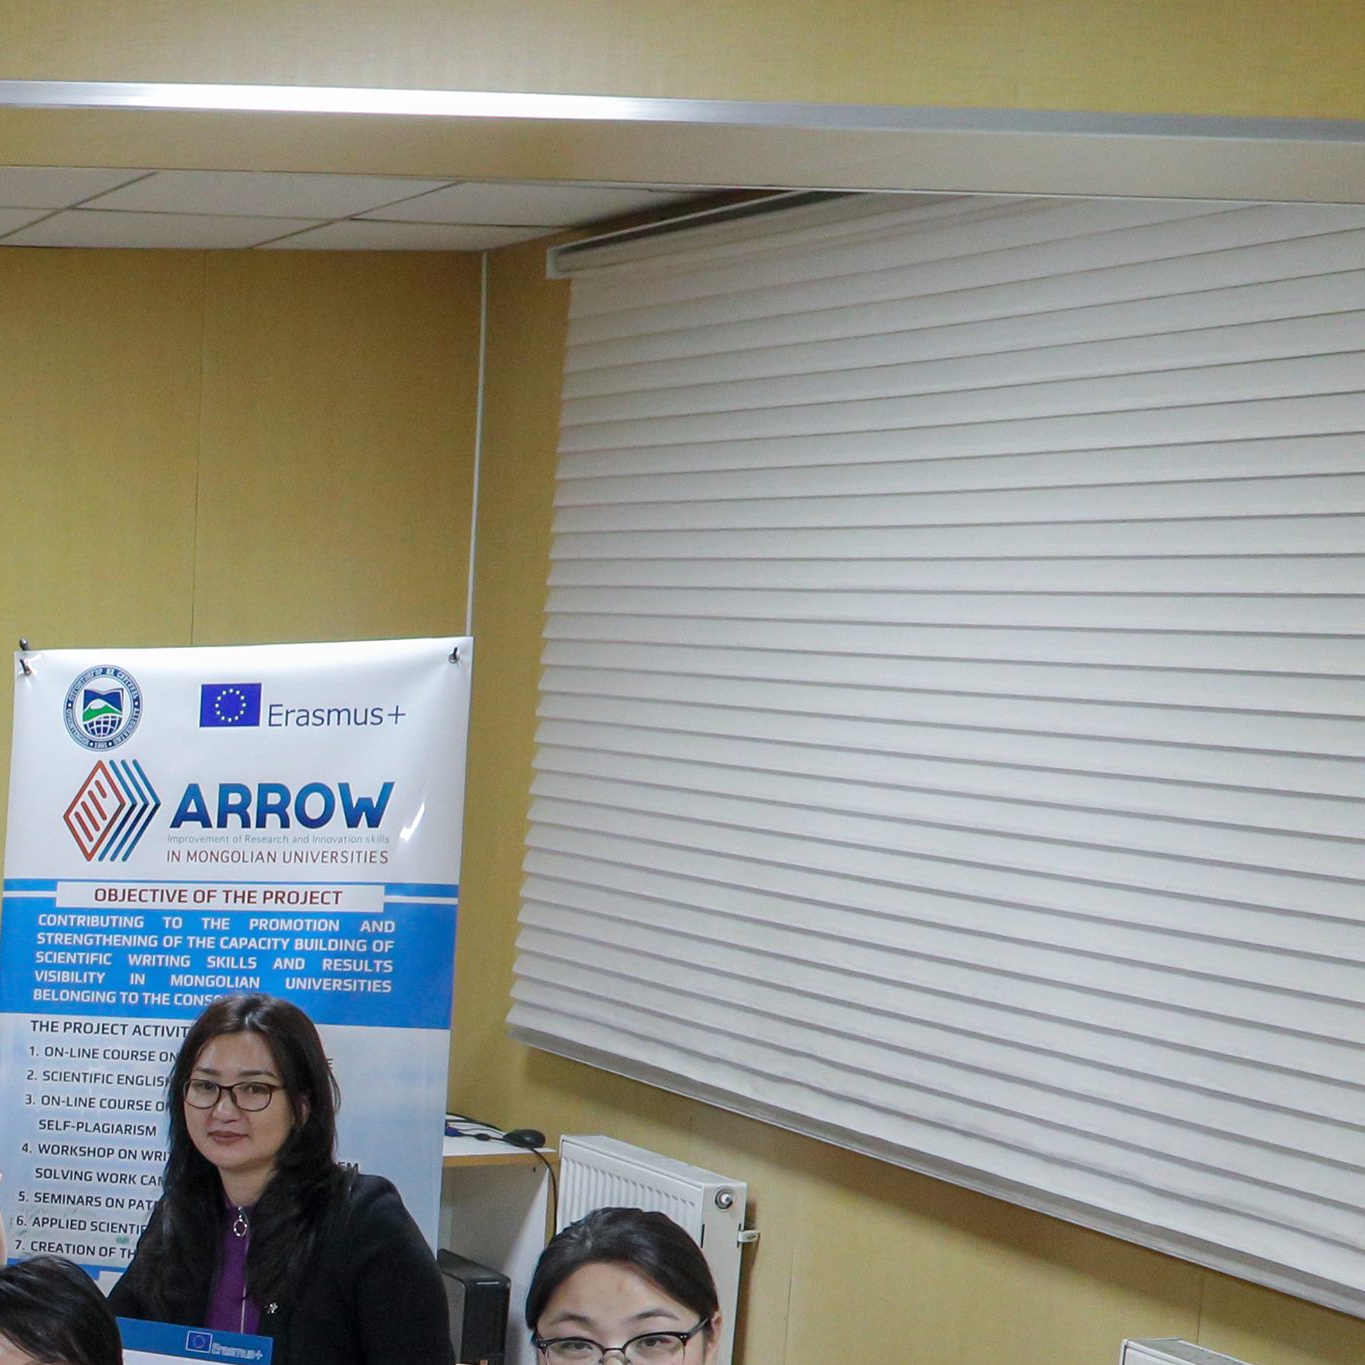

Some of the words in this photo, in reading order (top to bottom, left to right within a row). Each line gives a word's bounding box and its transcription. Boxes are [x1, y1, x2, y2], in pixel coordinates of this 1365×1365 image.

[268, 704, 406, 727] Erasmus+
[170, 782, 395, 829] ARROW
[168, 835, 229, 845] Improvement
[233, 834, 242, 843] of
[245, 835, 288, 844] Research
[292, 834, 309, 844] and
[312, 835, 362, 843] Innovation
[366, 834, 389, 843] skills
[167, 850, 180, 862] IN
[187, 850, 276, 863] MONGOLIAN
[283, 850, 388, 864] UNIVERSITIES
[94, 888, 188, 902] OBJECTIVE
[193, 890, 216, 903] OF
[223, 890, 257, 904] THE
[263, 891, 342, 905] PROJECT
[39, 914, 144, 928] CONTRIBUTING
[163, 917, 182, 928] TO
[202, 917, 230, 930] THE
[250, 919, 339, 931] PROMOTION
[361, 921, 395, 933] AND
[37, 933, 158, 947] STRENGTHENING
[163, 936, 182, 948] OF
[187, 937, 215, 948] THE
[220, 937, 289, 950] CAPACITY
[294, 939, 367, 951] BUILDING
[372, 940, 394, 952] OF
[36, 951, 112, 965] SCIENTIFIC
[128, 954, 190, 967] WRITING
[207, 956, 257, 969] SKILLS
[274, 958, 305, 970] AND
[323, 959, 393, 972] RESULTS
[35, 970, 105, 984] VISIBILITY
[130, 974, 145, 985] IN
[171, 974, 260, 988] MONGOLIAN
[286, 978, 392, 992] UNIVERSITIES
[33, 989, 116, 1003] BELONGING
[120, 992, 139, 1003] TO
[142, 993, 170, 1005] THE
[31, 1020, 58, 1032] THE
[63, 1022, 128, 1035] PROJECT
[132, 1024, 189, 1037] ACTIVIT
[29, 1046, 39, 1056] 1.
[45, 1047, 99, 1059] ON-LINE
[103, 1049, 155, 1061] COURSE
[27, 1070, 37, 1081] 2.
[43, 1071, 113, 1084] SCIENTIFIC
[25, 1095, 36, 1105] 3.
[41, 1095, 96, 1108] ON-LINE
[100, 1099, 152, 1111] COURSE
[39, 1119, 156, 1136] SELF-PLAGIARISM
[22, 1143, 32, 1153] 4.
[38, 1144, 114, 1158] WORKSHOP
[118, 1149, 137, 1160] ON
[35, 1168, 92, 1182] SOLVING
[97, 1172, 136, 1184] WORK
[19, 1191, 28, 1202] 5.
[34, 1192, 101, 1207] SEMINARS
[105, 1197, 124, 1208] ON
[16, 1216, 27, 1226] 6.
[32, 1217, 86, 1230] APPLIED
[15, 1240, 25, 1250] 7.
[31, 1241, 95, 1255] CREATION
[99, 1247, 117, 1257] OF
[120, 1248, 135, 1259] TH
